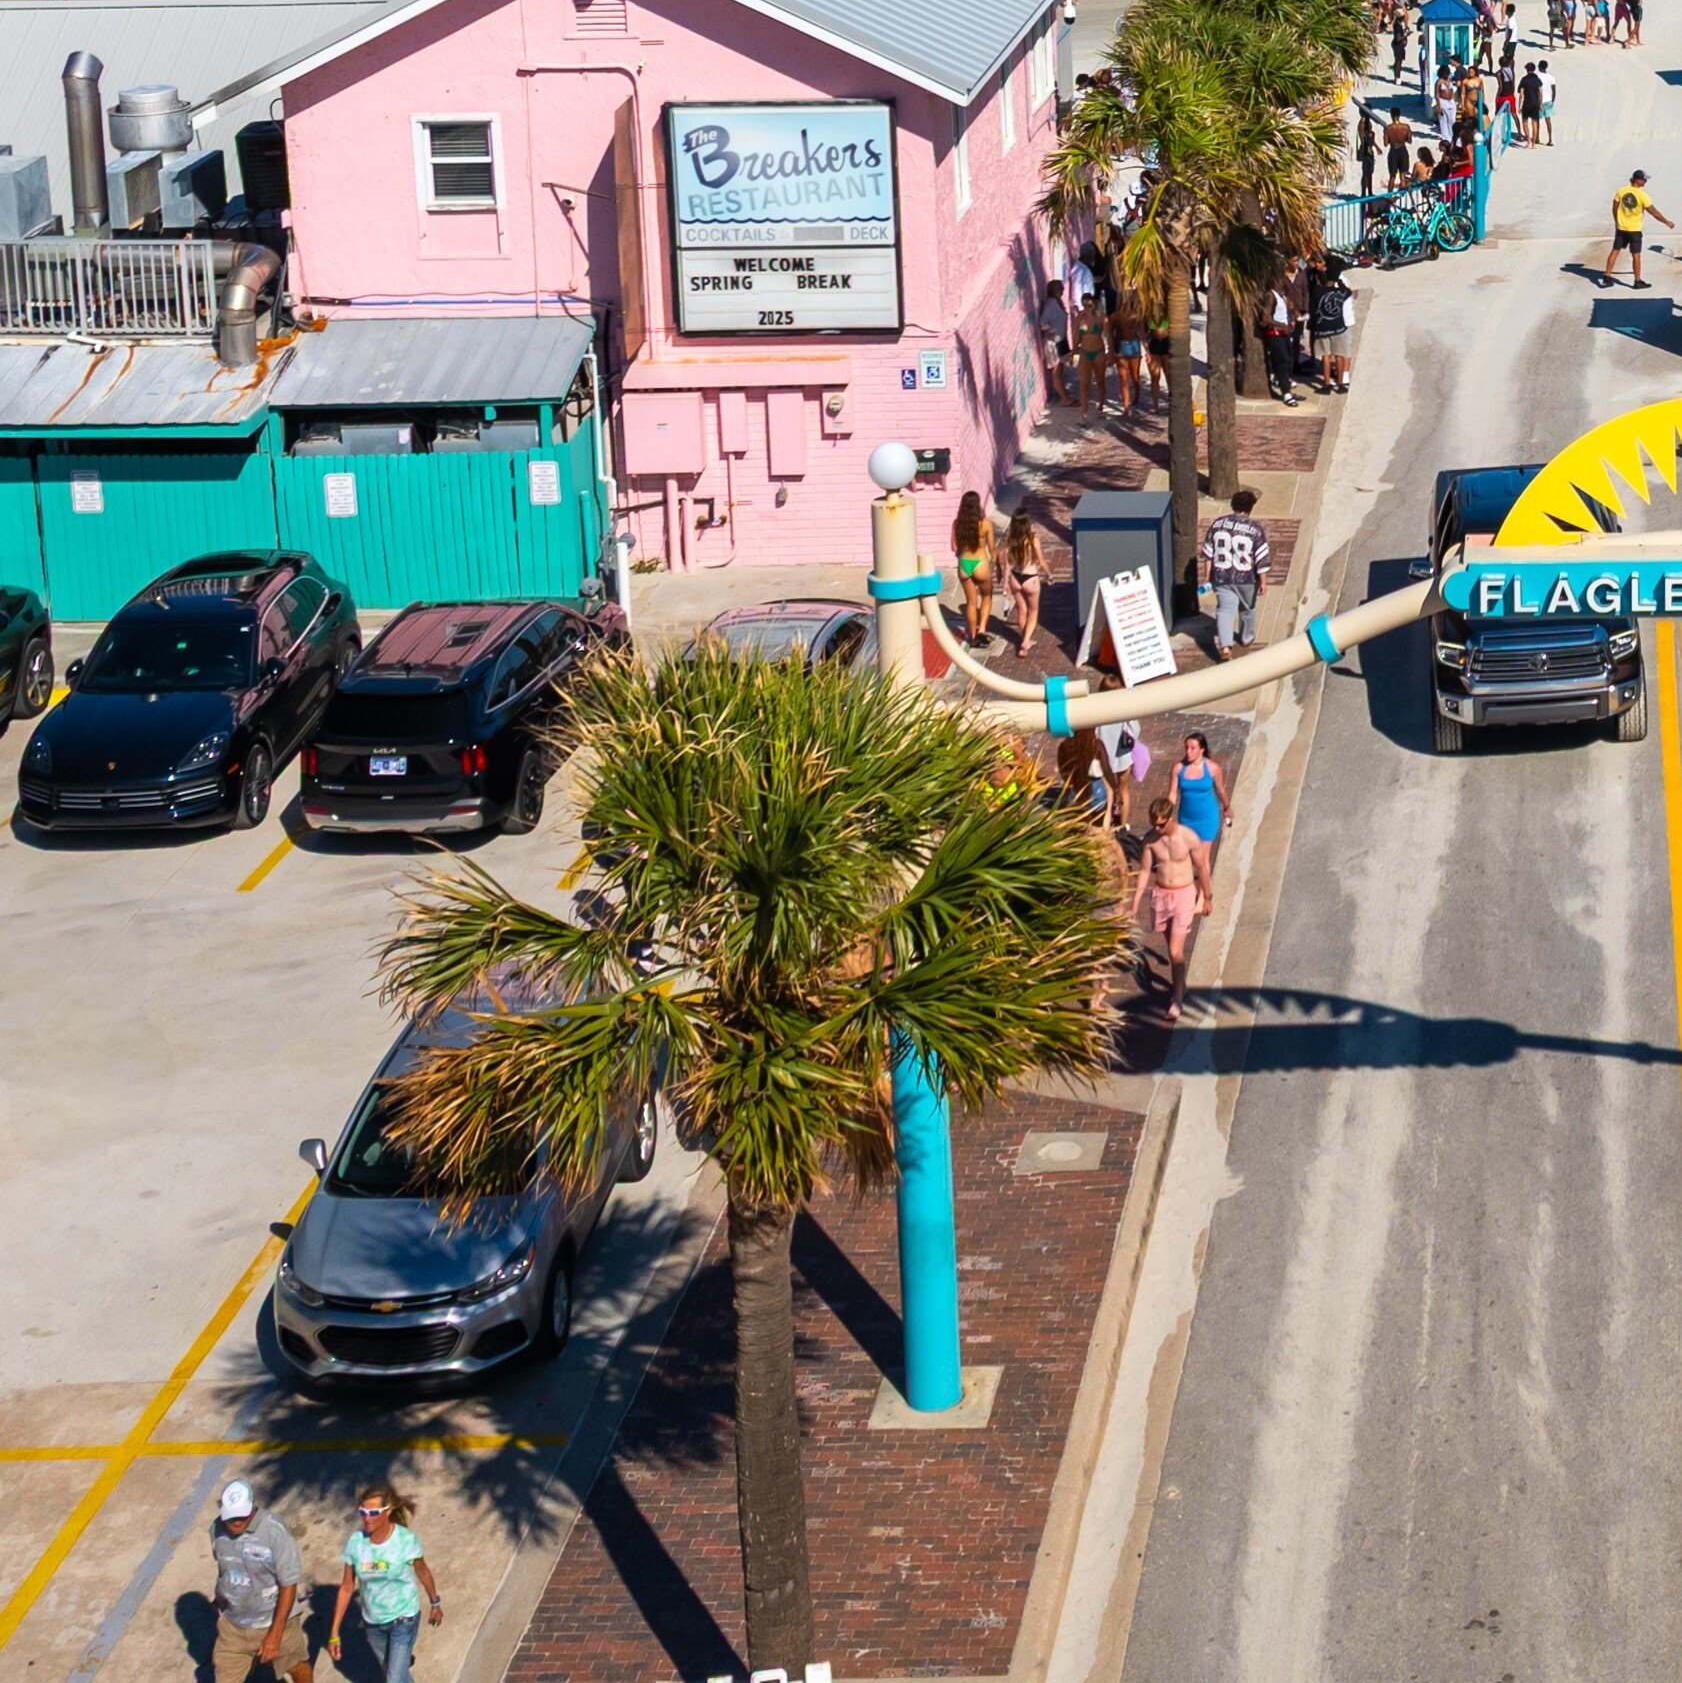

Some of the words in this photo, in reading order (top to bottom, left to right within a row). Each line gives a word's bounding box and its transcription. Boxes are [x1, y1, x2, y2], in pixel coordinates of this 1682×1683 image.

[689, 130, 717, 148] The
[684, 125, 882, 188] Breakers
[687, 173, 884, 217] RESTAURANT
[686, 227, 776, 242] COCKTAILS
[850, 226, 888, 240] DECK
[733, 258, 815, 272] WELCOME
[690, 276, 753, 291] SPRING
[797, 274, 851, 289] BREAK
[758, 311, 794, 325] 2025
[1213, 530, 1253, 571] 88
